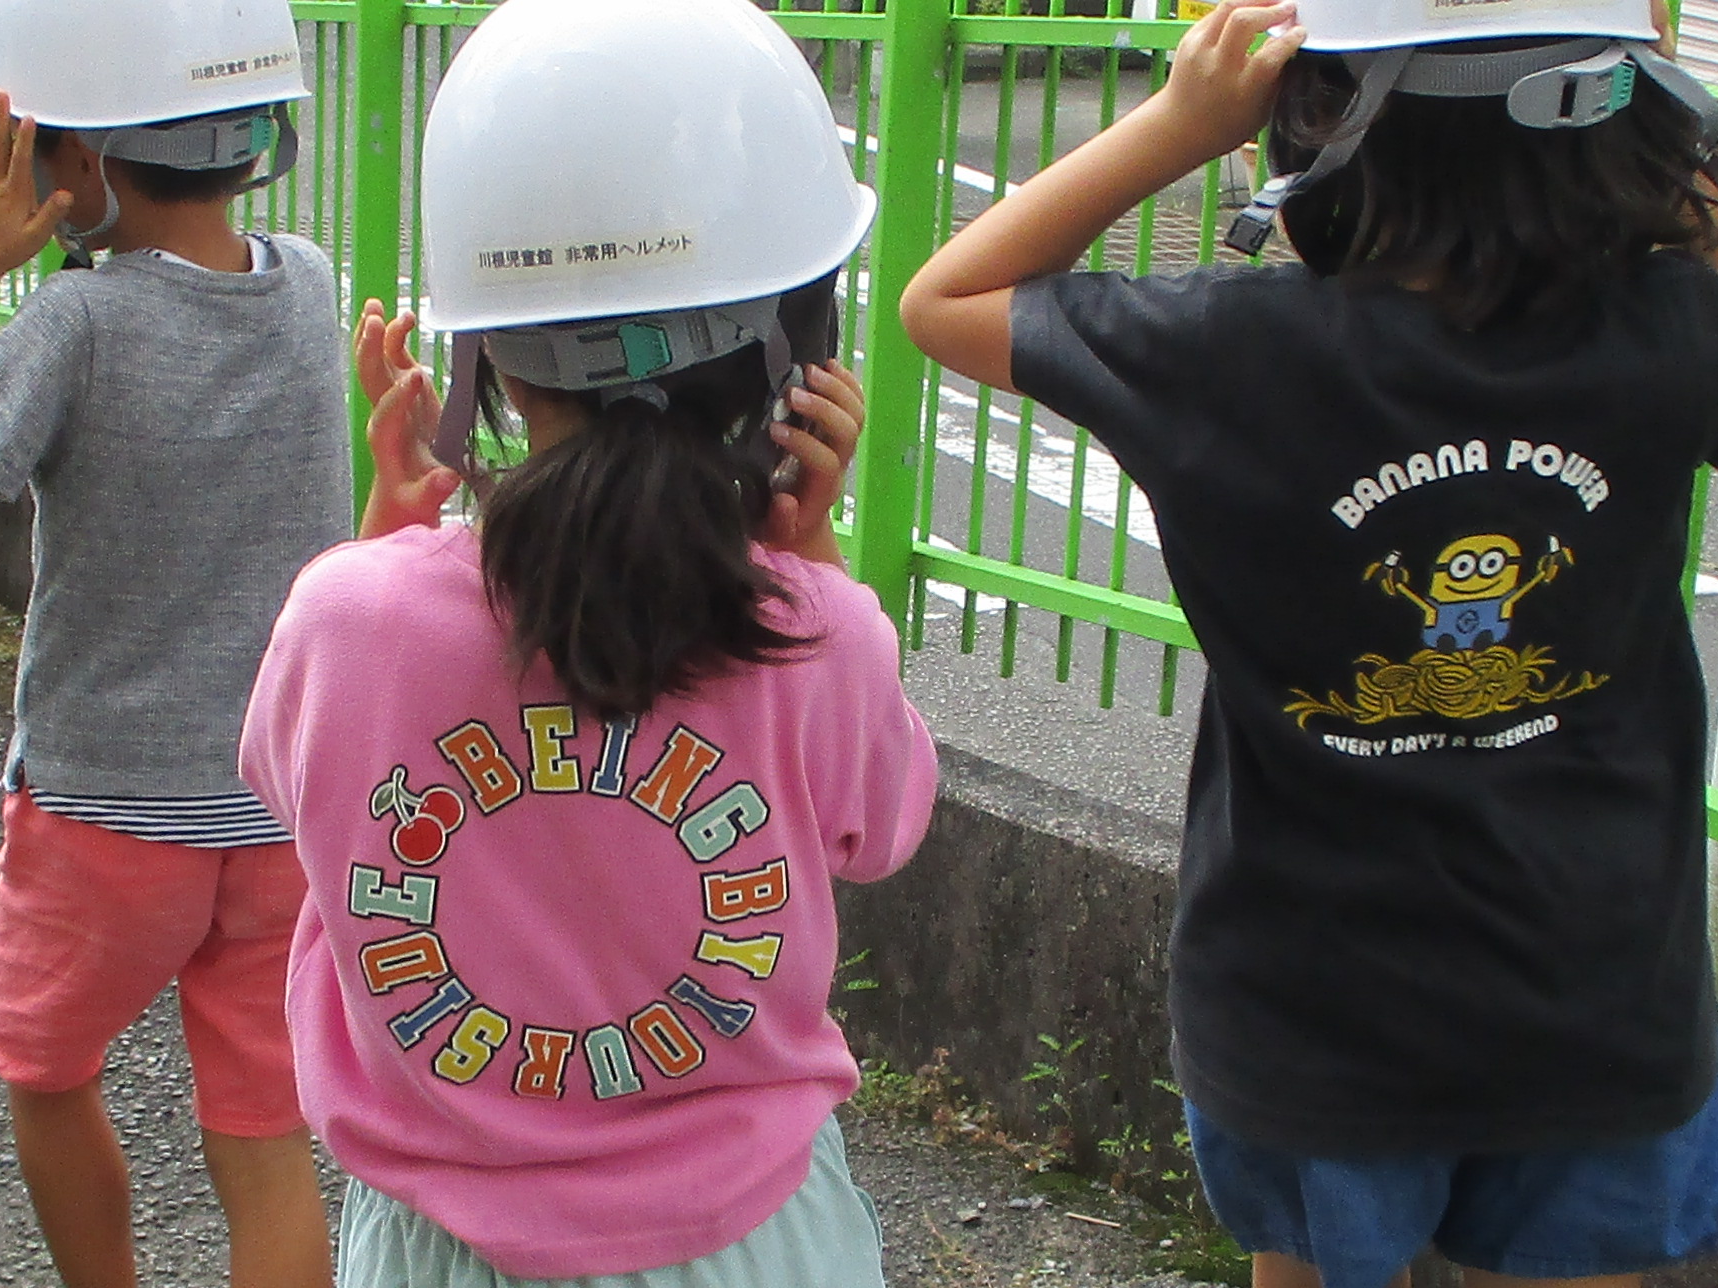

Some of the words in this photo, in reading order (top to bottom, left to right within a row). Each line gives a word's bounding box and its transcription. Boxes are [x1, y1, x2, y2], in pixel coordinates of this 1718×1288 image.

[478, 248, 553, 269] 川根児童館
[564, 234, 693, 264] 非常用ヘルメット
[1331, 438, 1489, 530] BANANA
[1505, 438, 1611, 513] POWER
[1322, 733, 1387, 757] EVERY
[1473, 713, 1561, 750] WEEKEND
